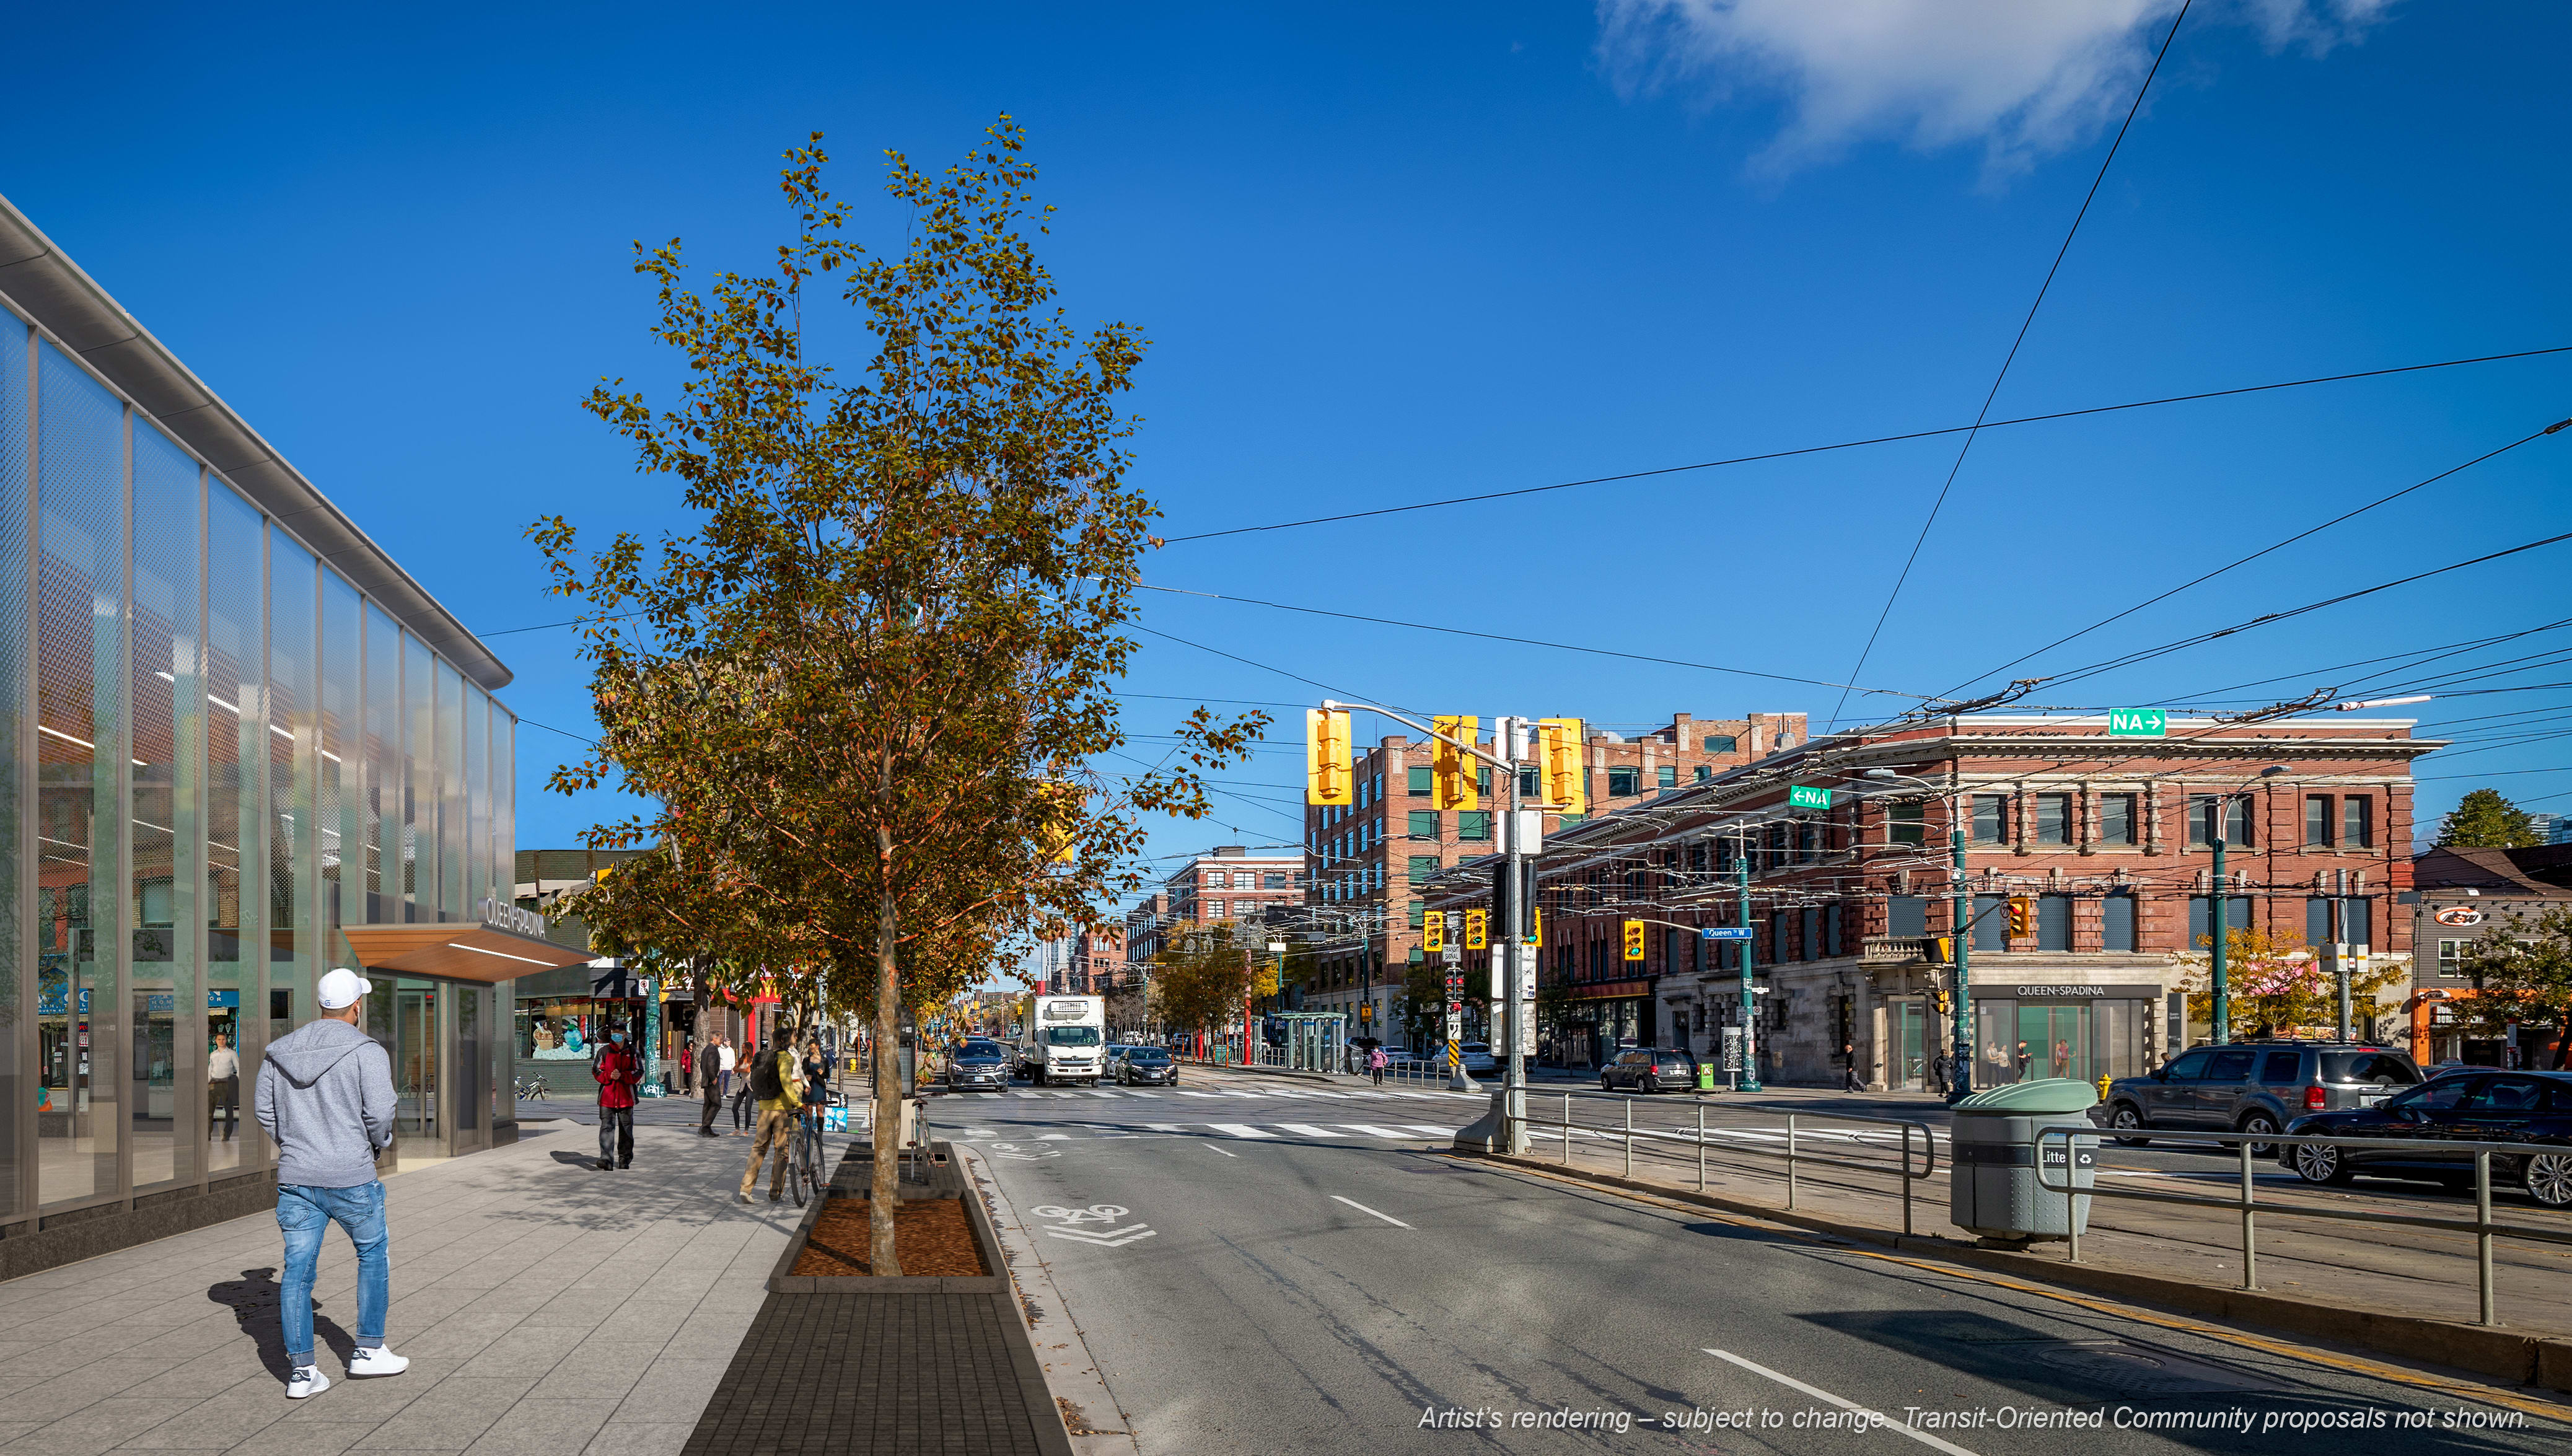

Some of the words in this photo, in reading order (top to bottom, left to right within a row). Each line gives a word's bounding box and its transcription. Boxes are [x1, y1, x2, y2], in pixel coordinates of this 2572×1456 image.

[2113, 714, 2143, 730] NA
[1806, 791, 1827, 805] NA
[486, 898, 545, 939] QUEEN-SPADINA
[2017, 986, 2104, 996] QUEEN-SPADINA
